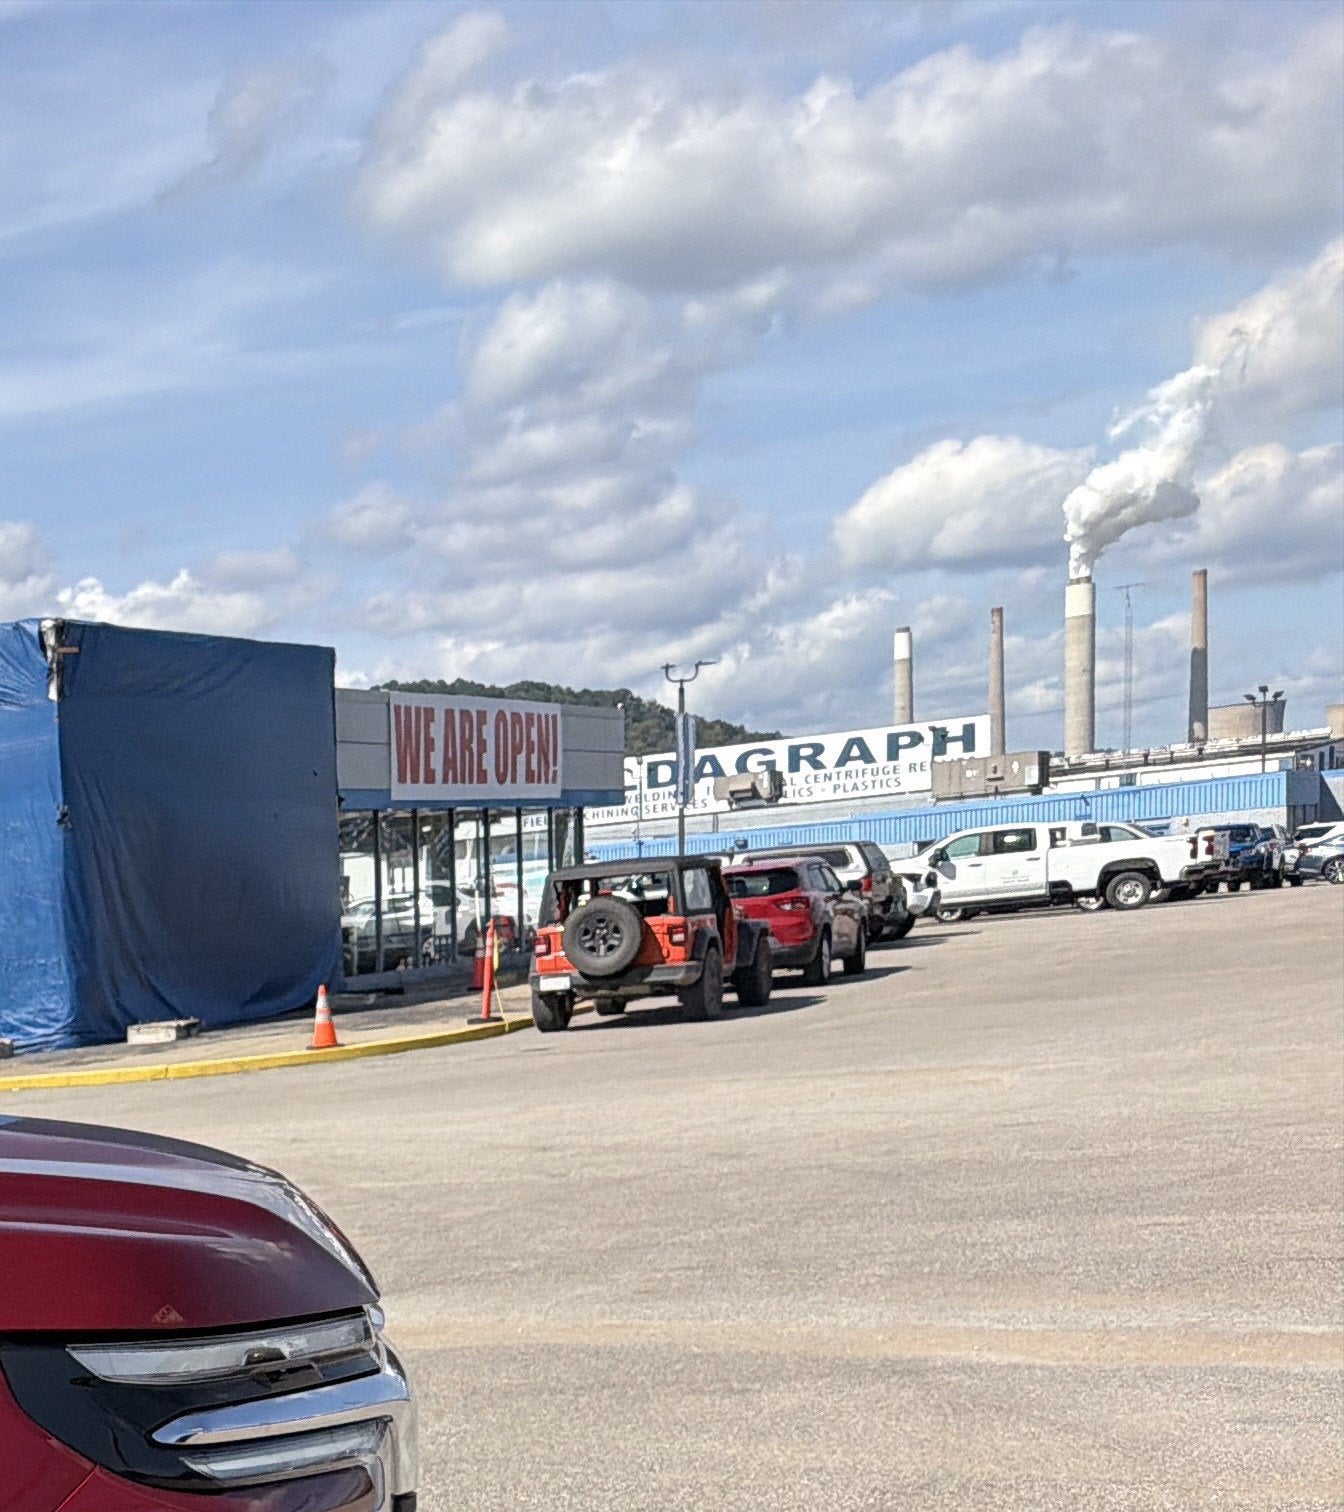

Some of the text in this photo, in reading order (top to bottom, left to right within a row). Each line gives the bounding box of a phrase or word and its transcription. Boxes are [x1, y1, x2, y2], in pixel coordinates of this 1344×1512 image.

[393, 704, 559, 785] WE ARE OPEN!
[804, 764, 901, 785] CENTRIFUGE
[833, 776, 902, 795] PLASTICS
